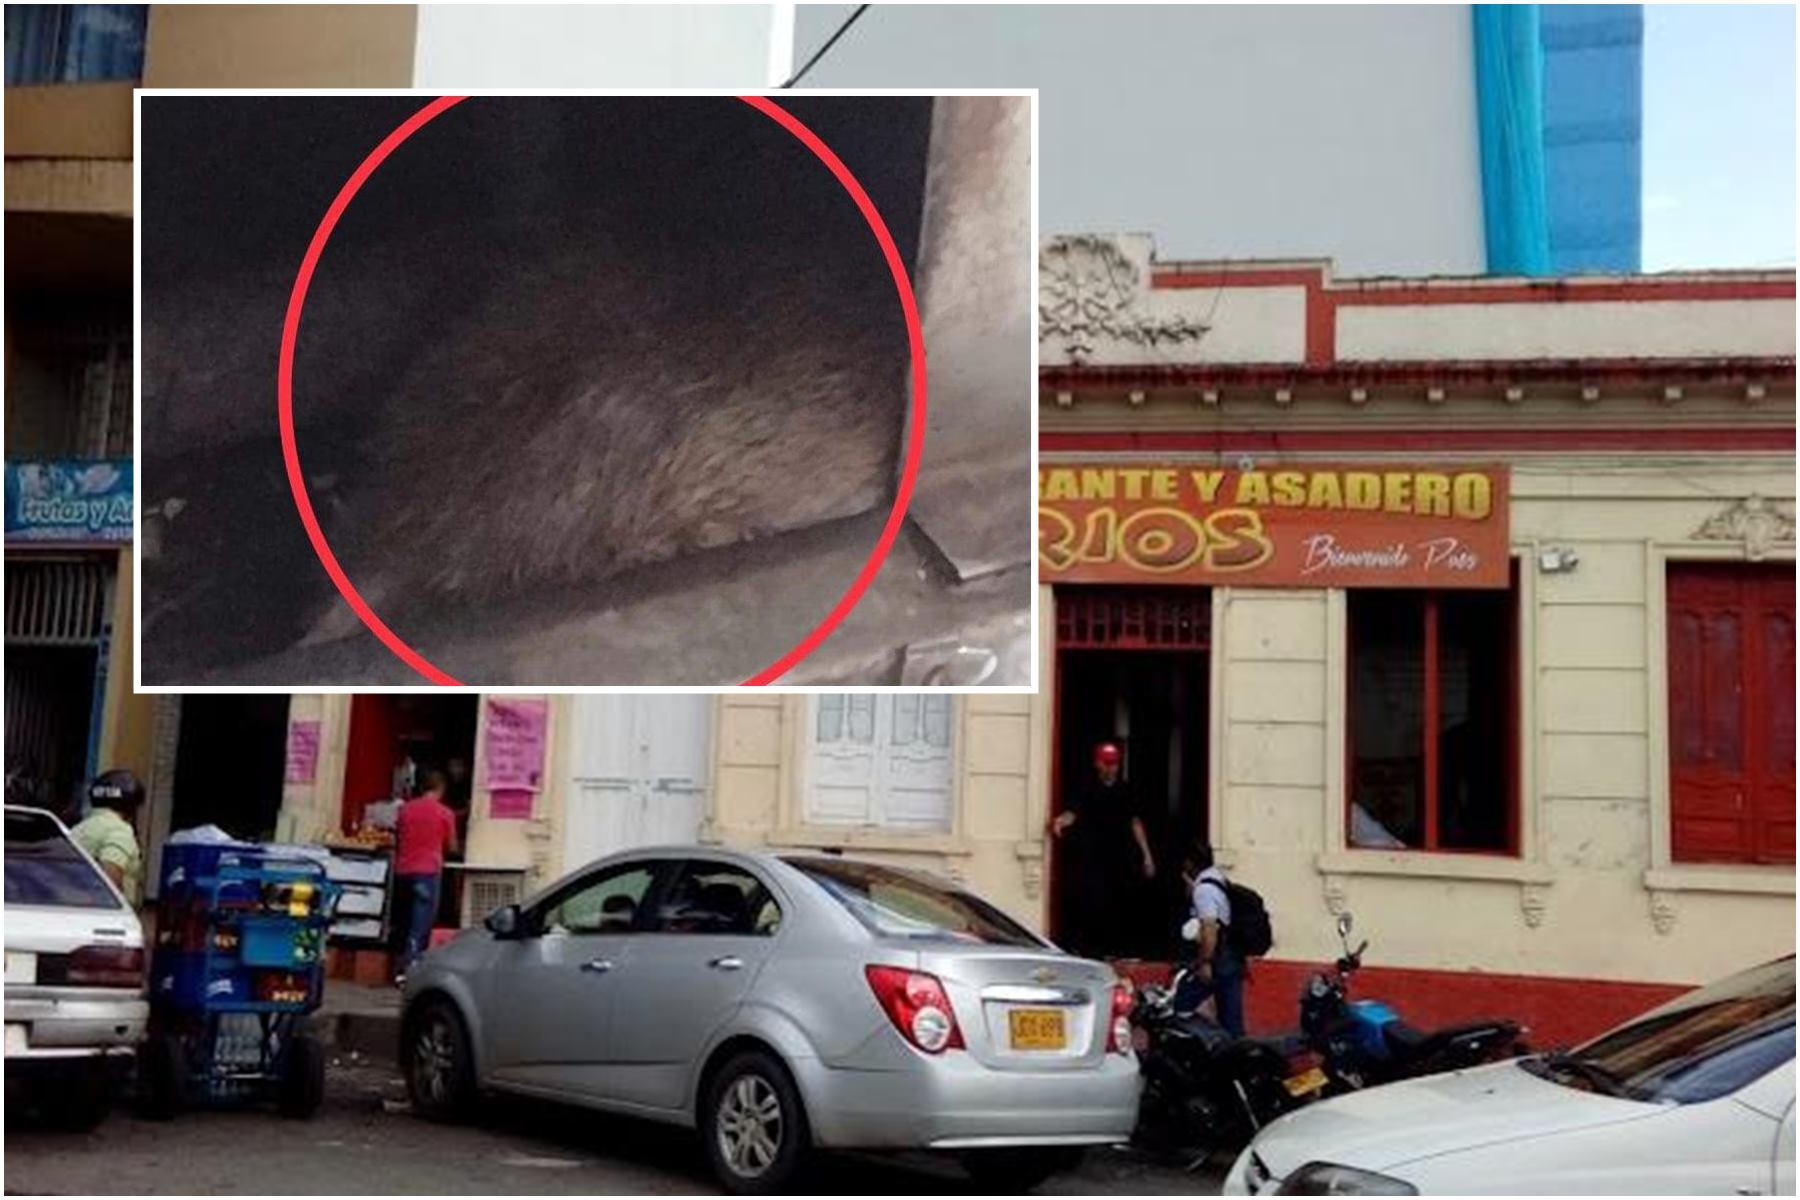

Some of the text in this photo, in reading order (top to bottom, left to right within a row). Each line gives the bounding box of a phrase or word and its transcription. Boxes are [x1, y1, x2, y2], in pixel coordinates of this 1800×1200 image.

[1039, 469, 1491, 520] ANTE Y ASADERO
